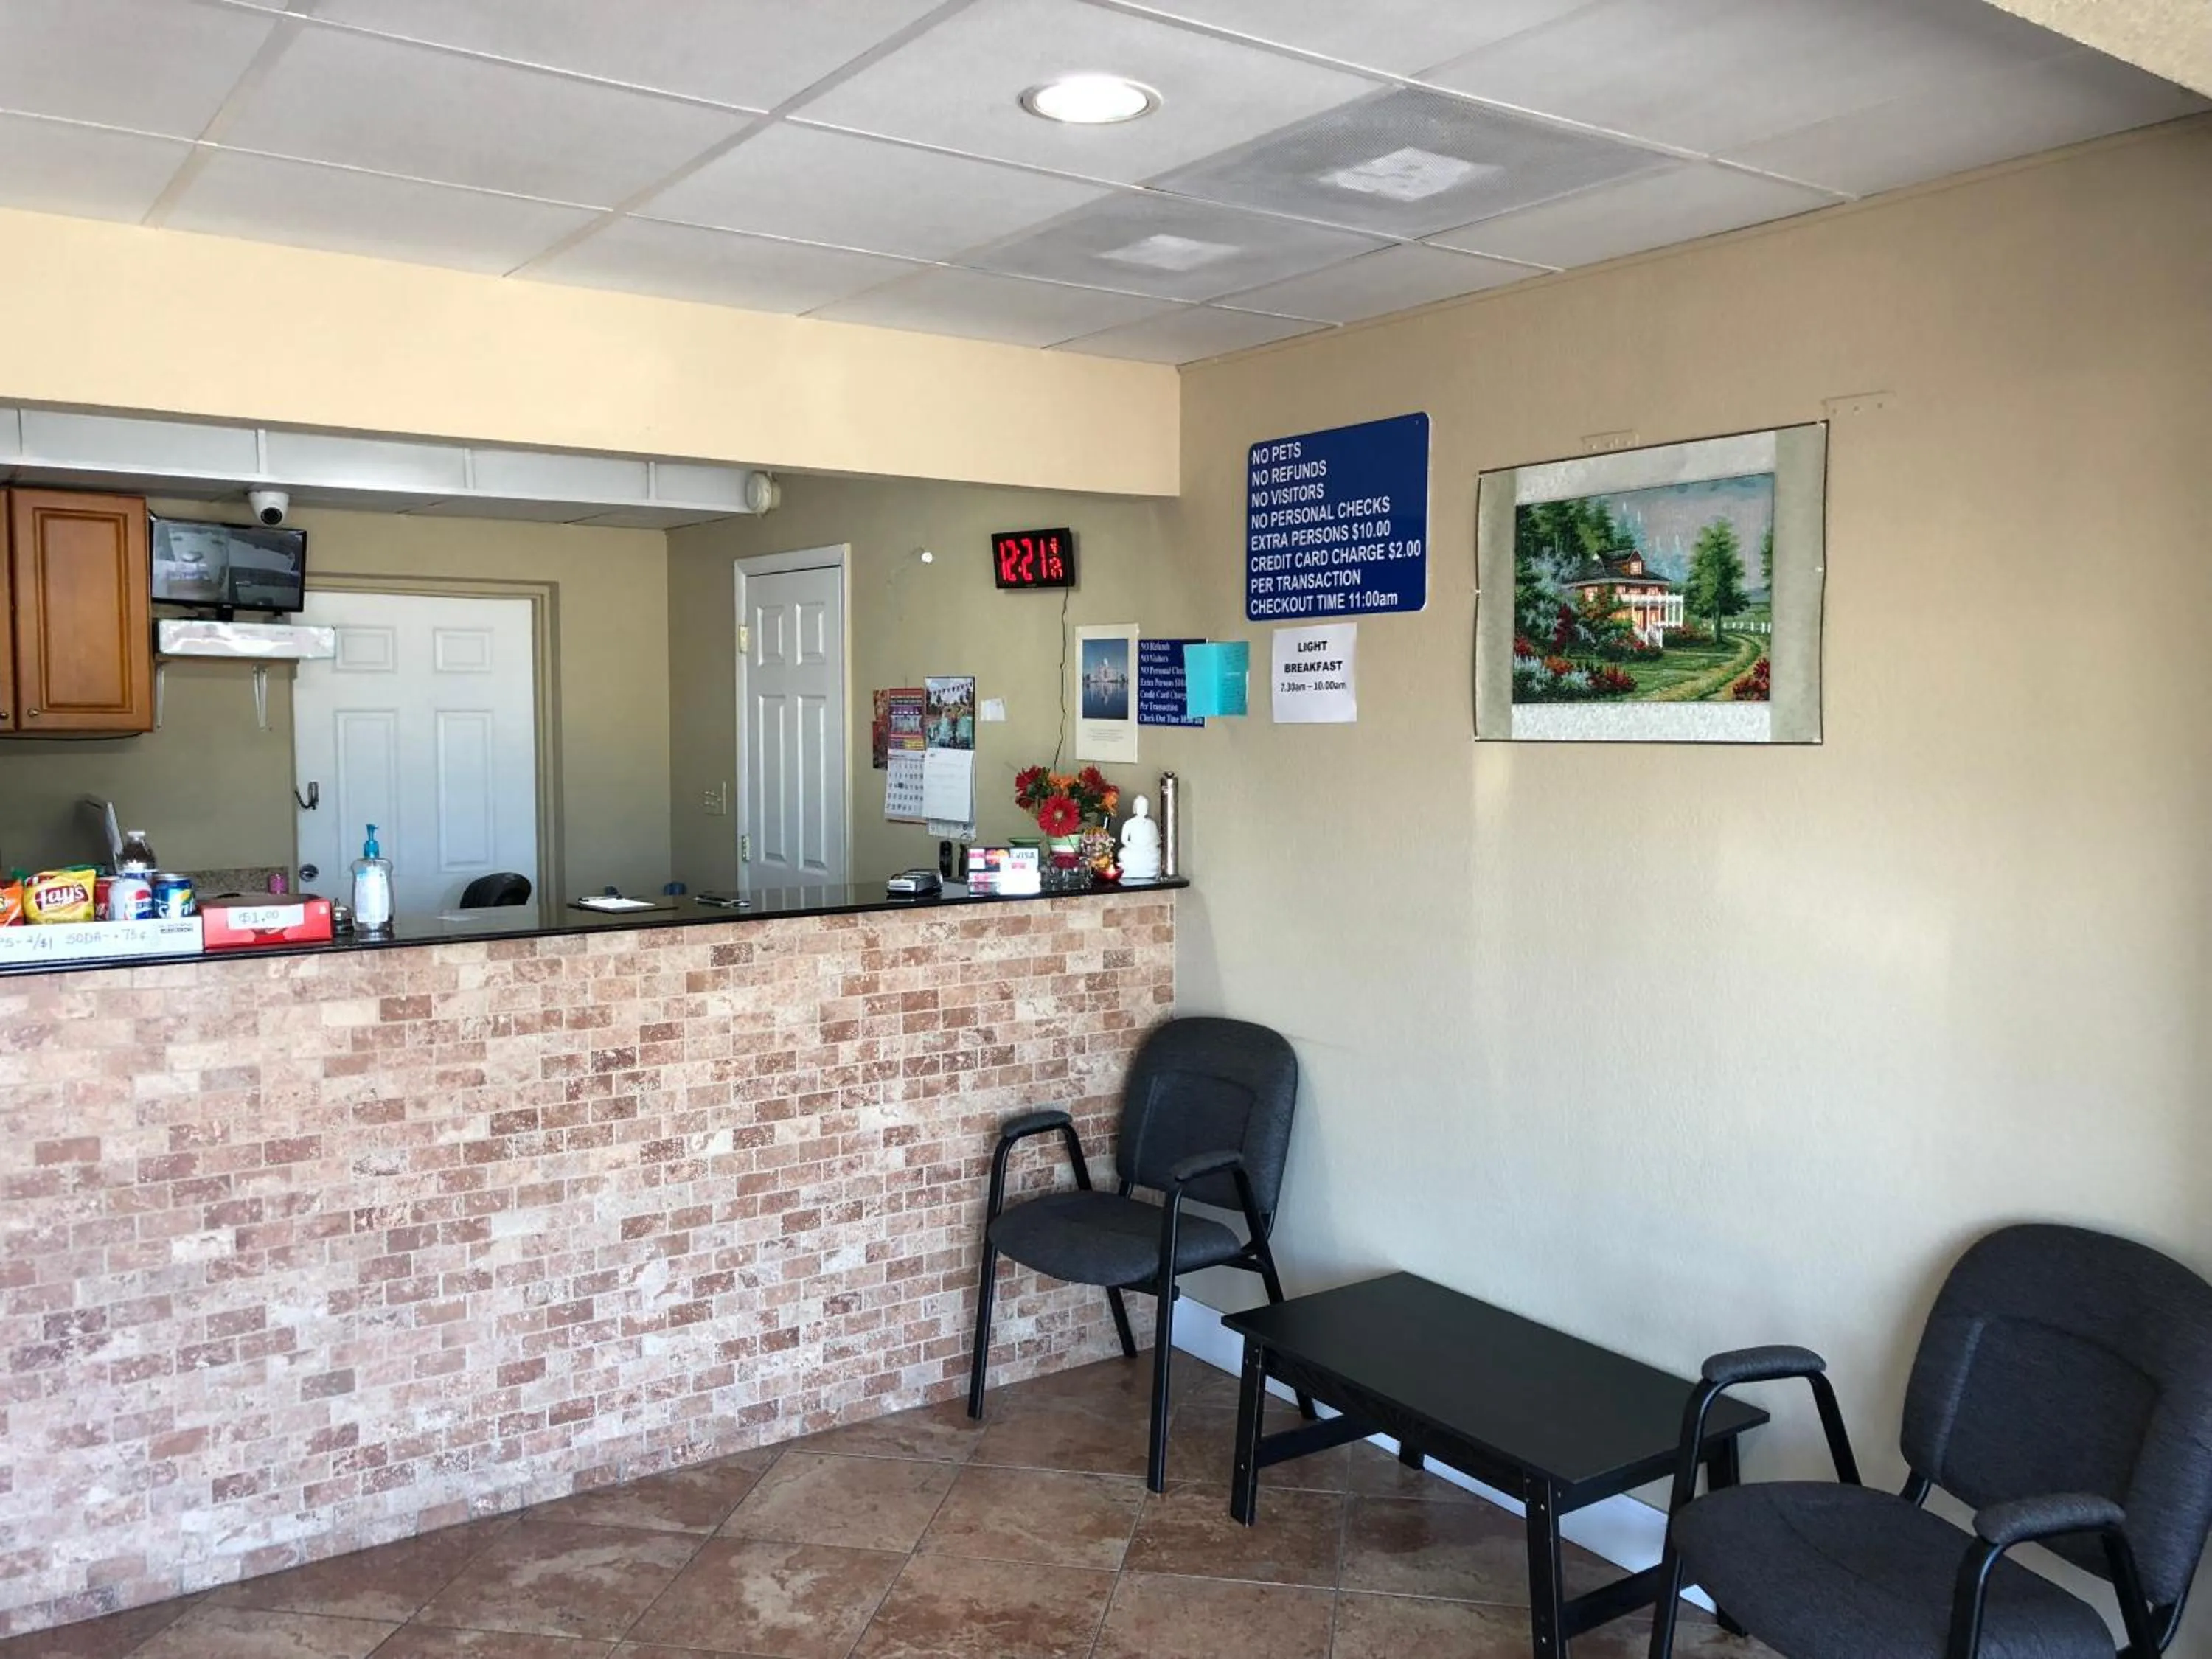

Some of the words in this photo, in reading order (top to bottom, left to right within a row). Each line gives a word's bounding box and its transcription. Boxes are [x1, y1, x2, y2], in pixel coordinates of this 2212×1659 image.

[1252, 448, 1269, 465] NO
[1272, 442, 1301, 462] PETS
[1251, 470, 1268, 487] NO
[1271, 459, 1326, 484] REFUNDS
[1251, 491, 1268, 508] NO
[1270, 483, 1324, 505] VISITORS
[1251, 512, 1267, 529] NO
[1270, 505, 1335, 527] PERSONAL
[1338, 495, 1391, 518] CHECKS
[1251, 532, 1288, 551] EXTRA
[1291, 525, 1349, 546] PERSONS
[1352, 519, 1391, 540] $10.00
[1251, 553, 1292, 572] CREDIT
[1295, 549, 1328, 568] CARD
[1332, 543, 1385, 564] CHARGE
[1388, 539, 1422, 560] $2.00
[1251, 577, 1273, 594] PER
[1276, 568, 1362, 591] TRANSACTION
[1250, 596, 1314, 615] CHECKOUT
[1317, 593, 1346, 611] TIME
[1349, 590, 1399, 608] 11:00am
[1298, 641, 1328, 653] LIGHT
[1284, 660, 1343, 673] BREAKFAST
[238, 910, 280, 924] $1.00
